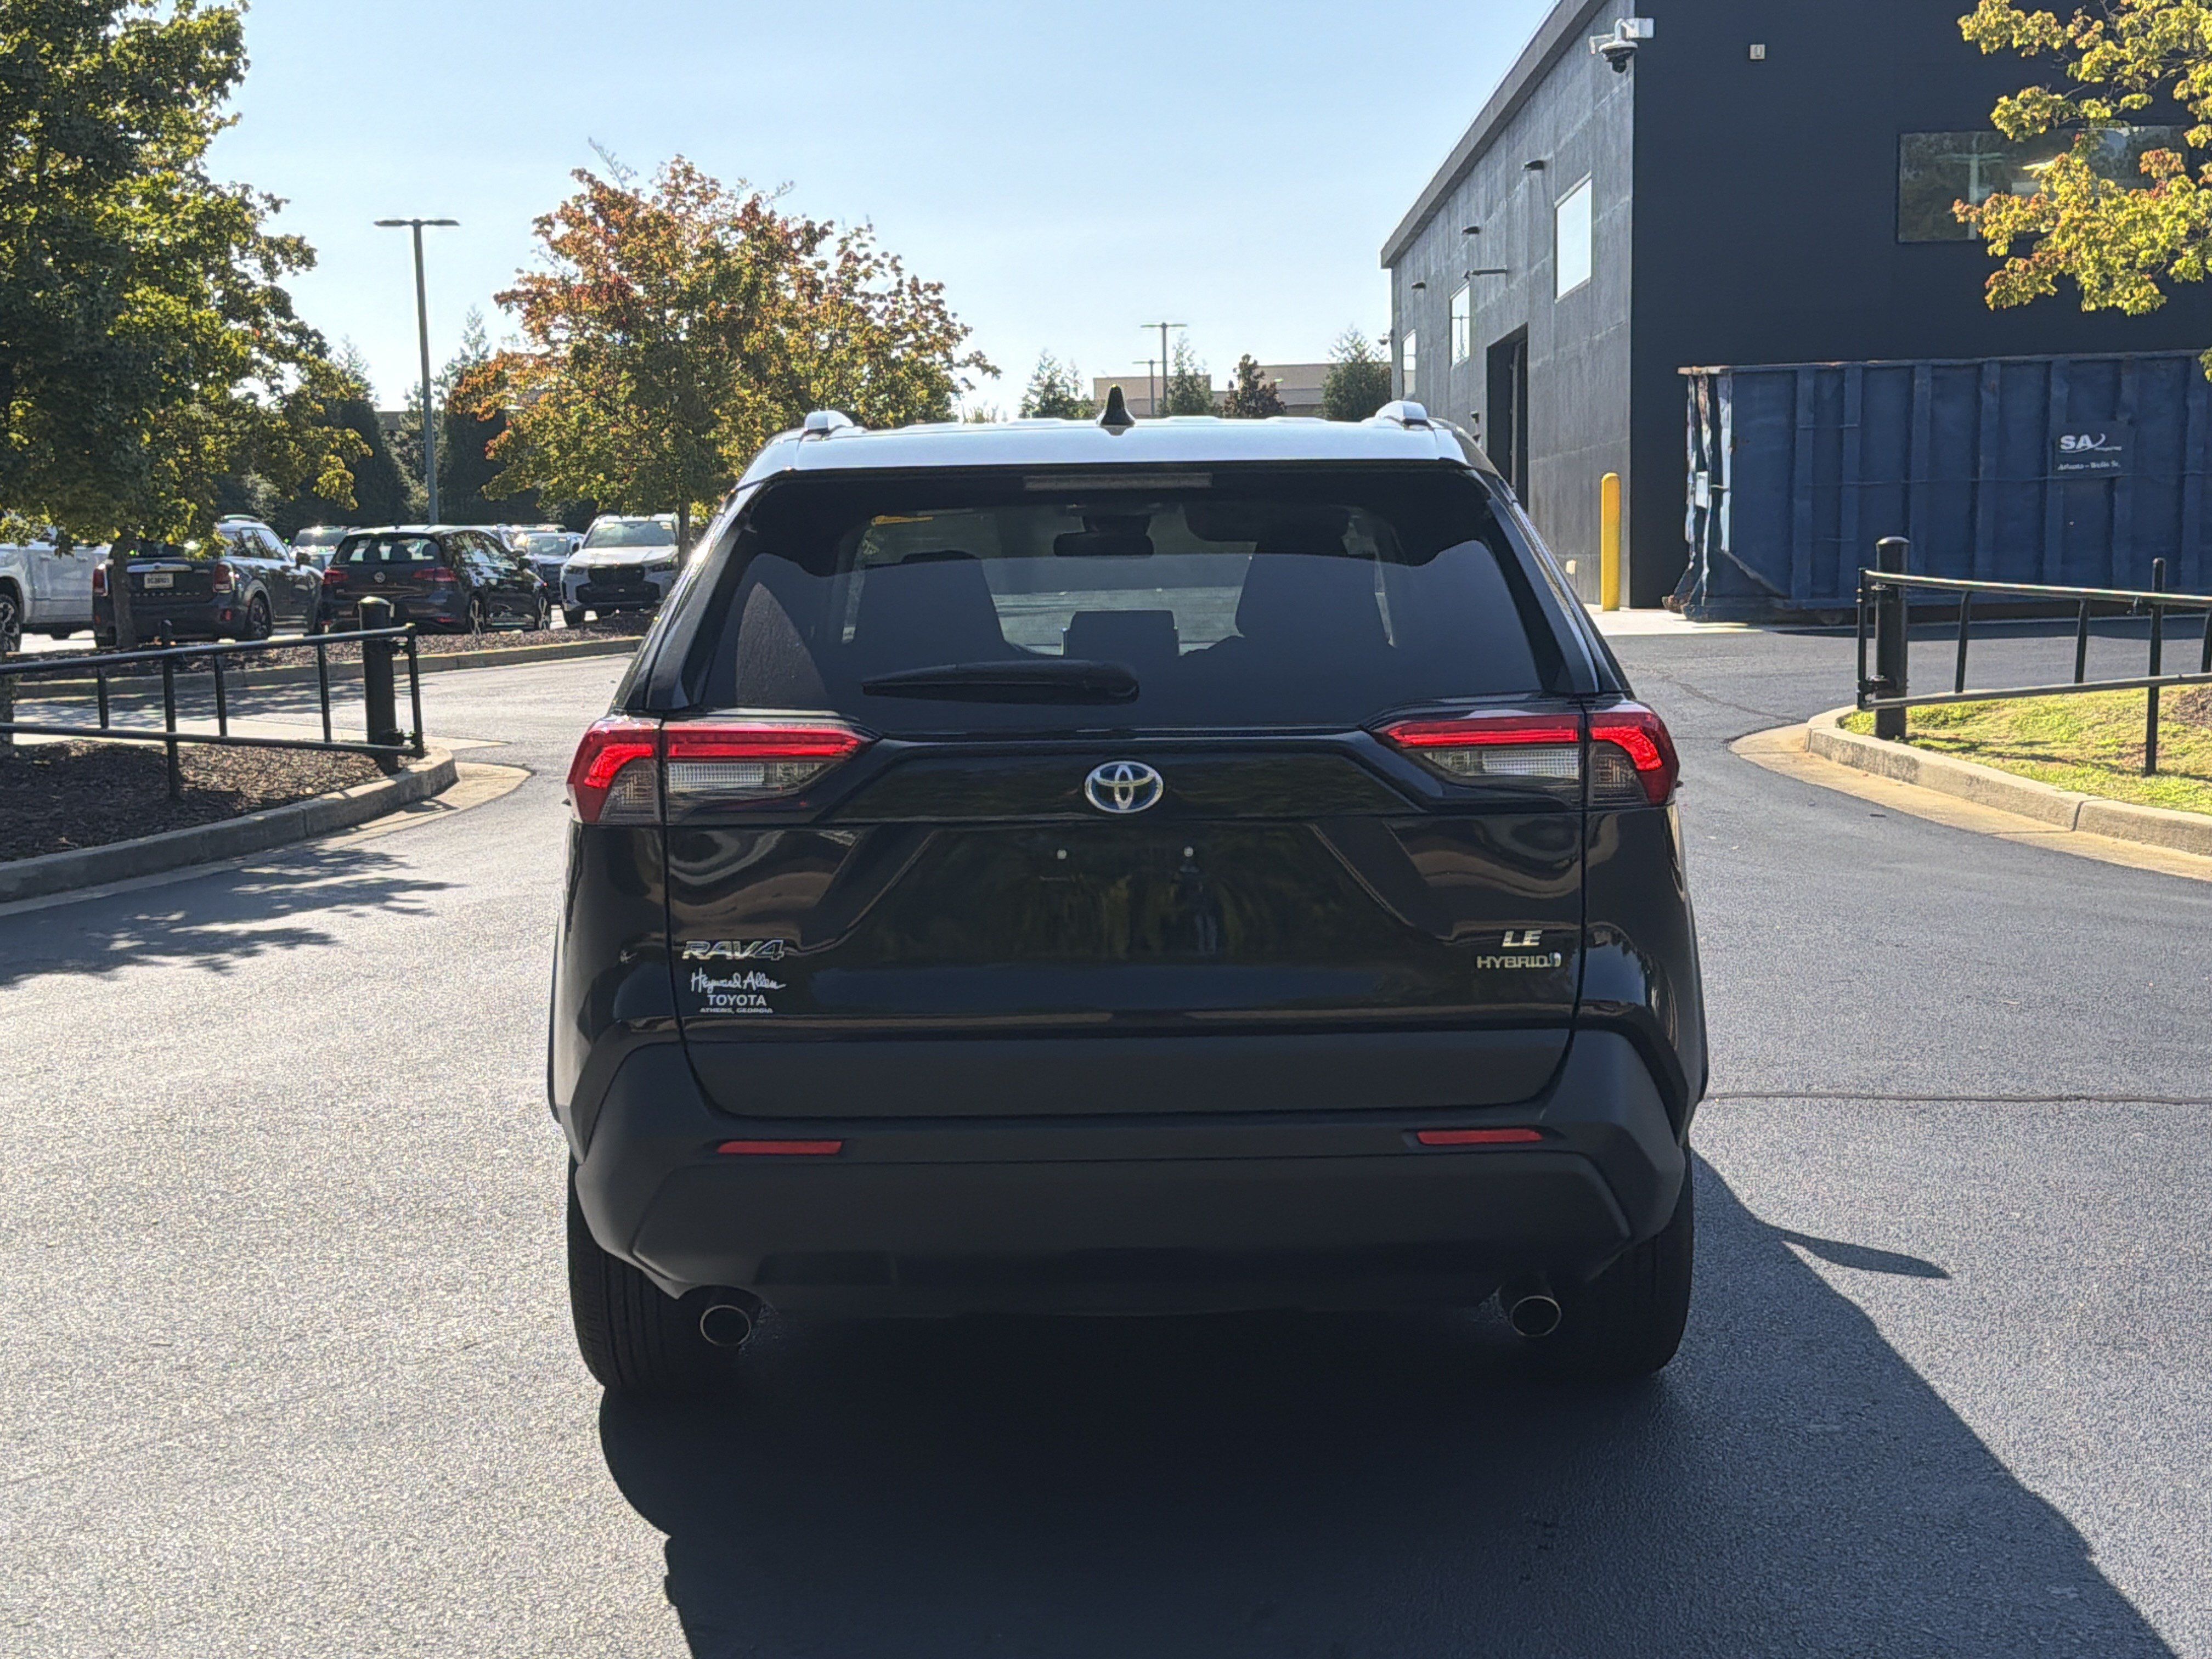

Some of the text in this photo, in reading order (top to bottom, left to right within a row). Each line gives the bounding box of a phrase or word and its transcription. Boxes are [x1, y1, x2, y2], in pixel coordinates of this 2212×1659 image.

[2060, 434, 2094, 450] SA
[1502, 929, 1543, 947] LE
[682, 939, 785, 960] RAV4
[1477, 955, 1551, 969] HYBRID
[707, 995, 767, 1006] TOYOTA
